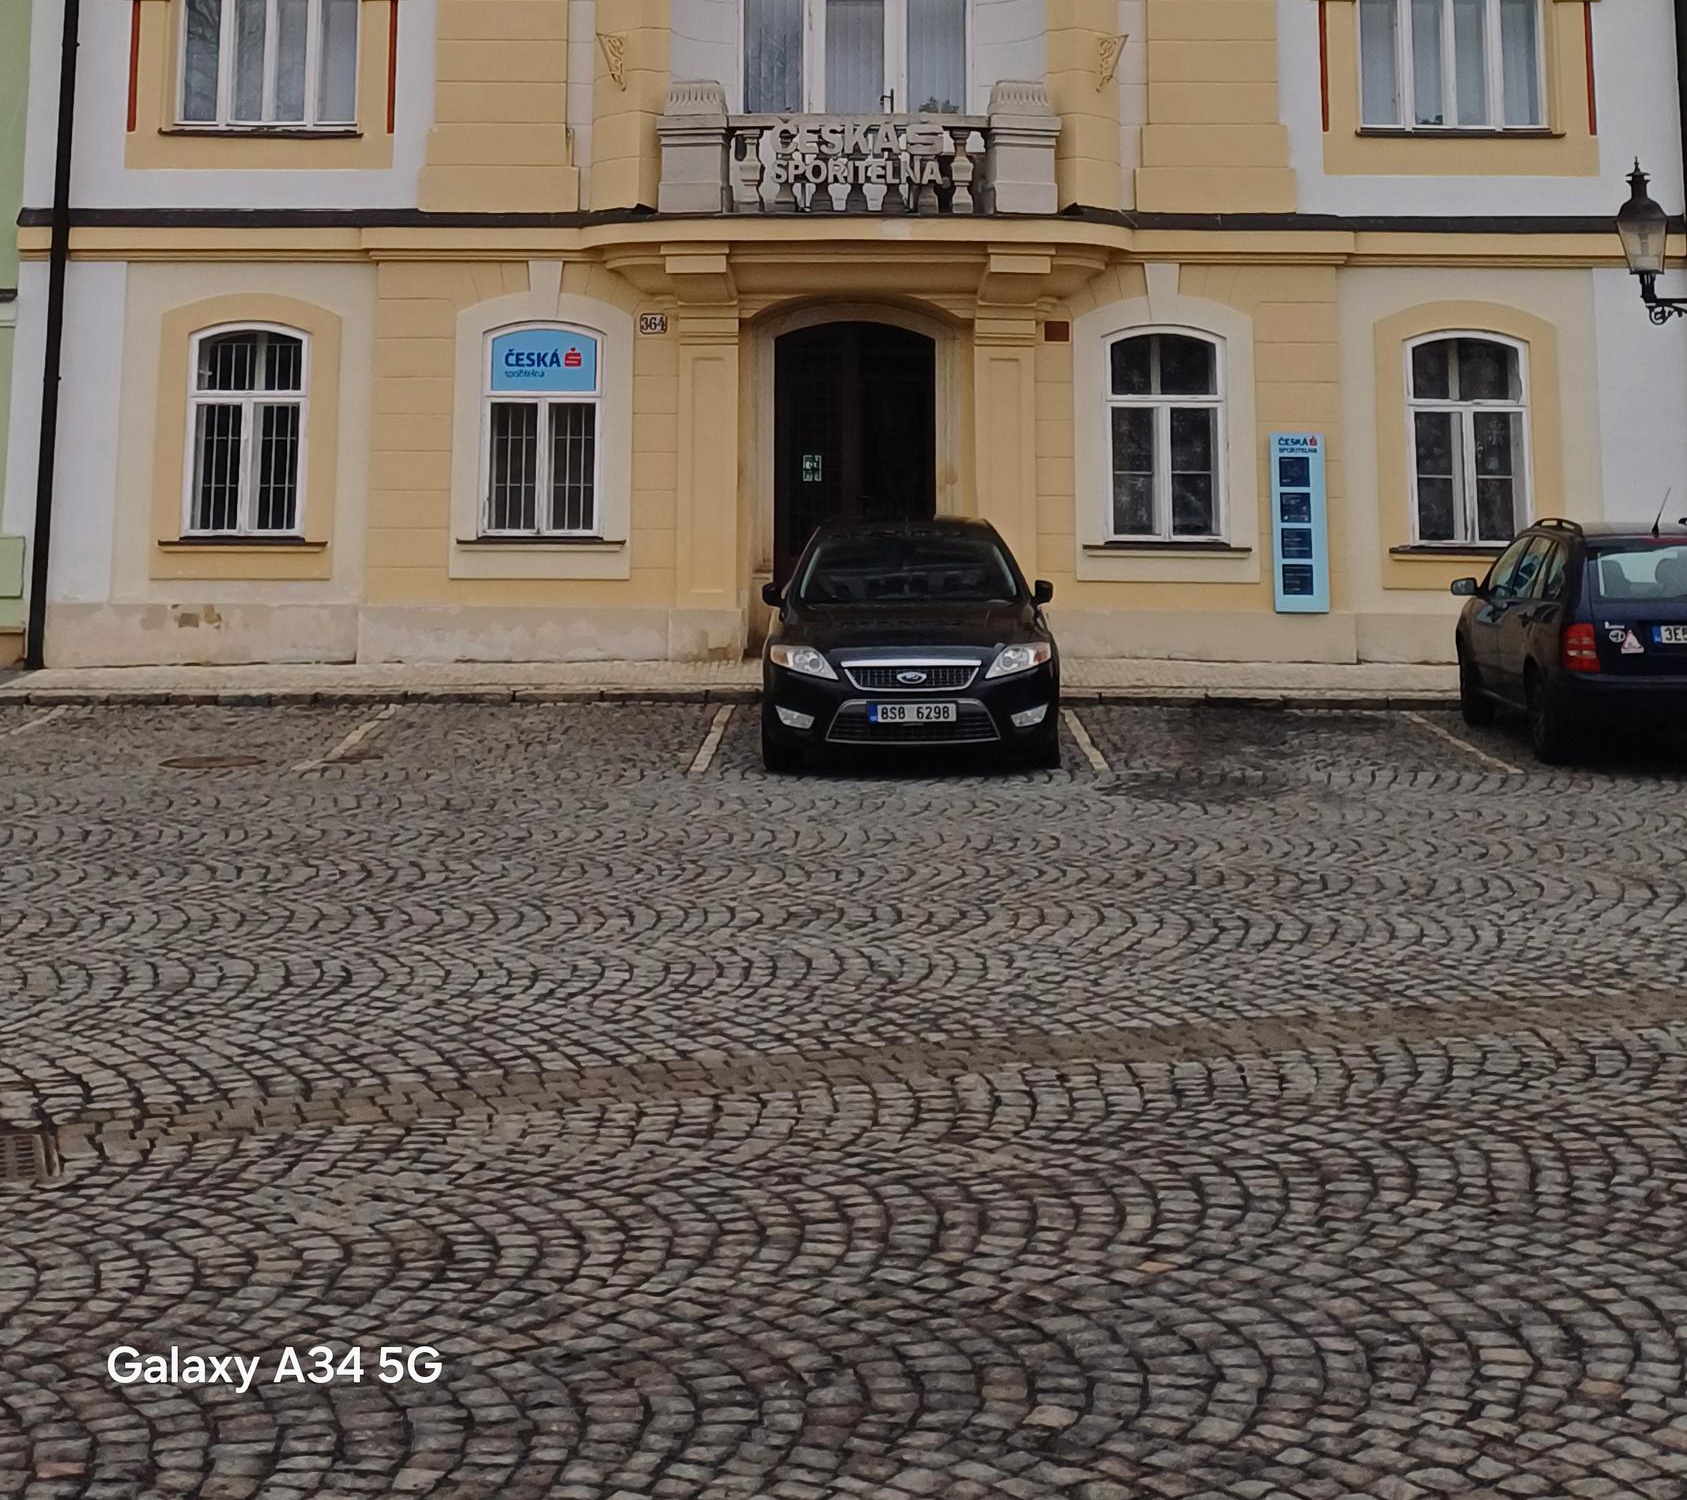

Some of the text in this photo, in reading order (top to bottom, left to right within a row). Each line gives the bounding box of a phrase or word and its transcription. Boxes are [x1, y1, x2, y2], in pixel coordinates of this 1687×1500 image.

[771, 116, 900, 155] ČESKÁ
[773, 156, 944, 185] SPOŘITELNA
[641, 316, 666, 331] 364
[504, 348, 561, 367] ČESKÁ
[916, 705, 950, 720] 6298
